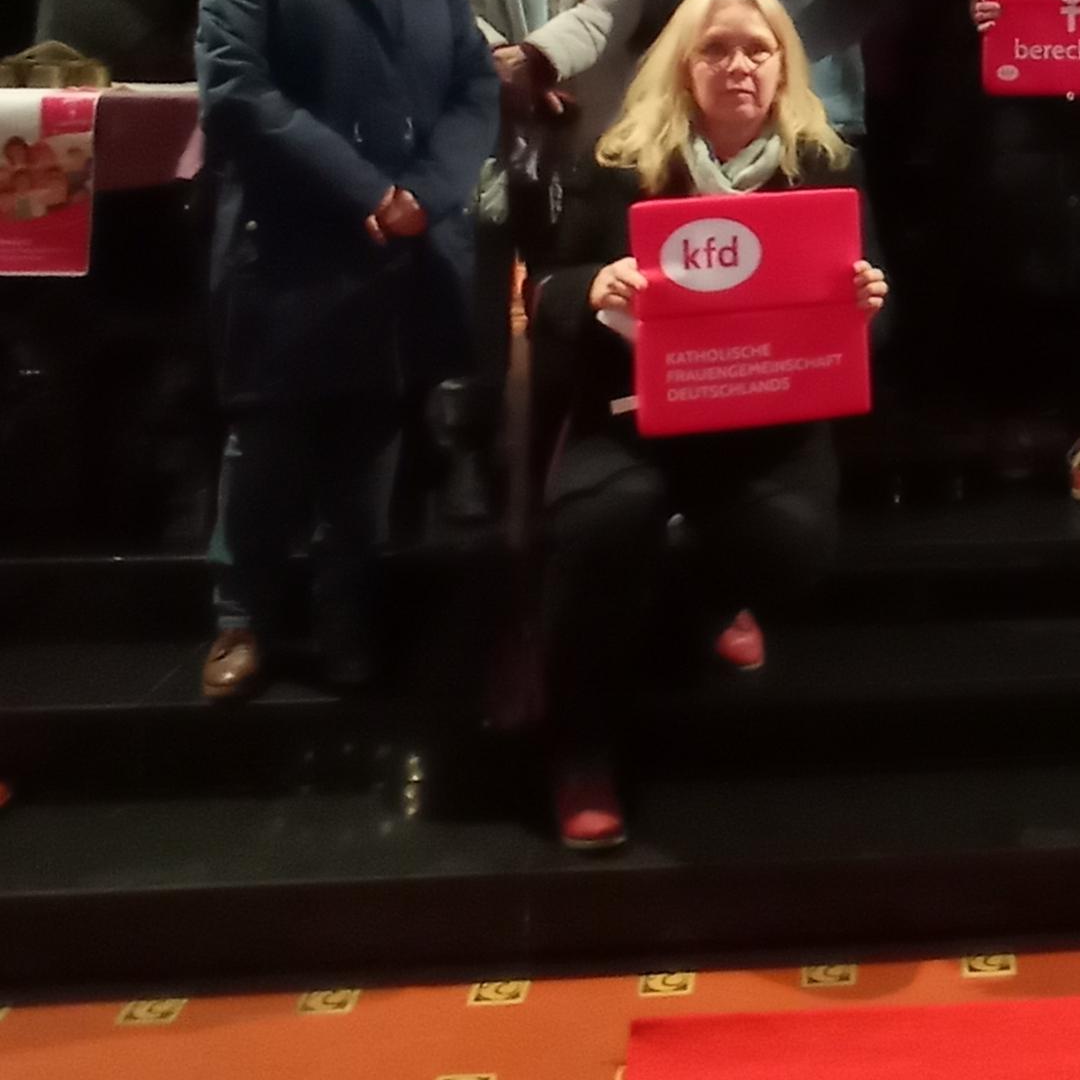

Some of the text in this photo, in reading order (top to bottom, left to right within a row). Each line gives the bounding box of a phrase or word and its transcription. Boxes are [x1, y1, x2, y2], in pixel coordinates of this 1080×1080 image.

[682, 235, 738, 270] kfd
[666, 343, 771, 365] KATHOLISCHE
[666, 353, 843, 383] FRAUENGEMEINSCHAFT
[667, 377, 790, 402] DEUTSCHLANDS
